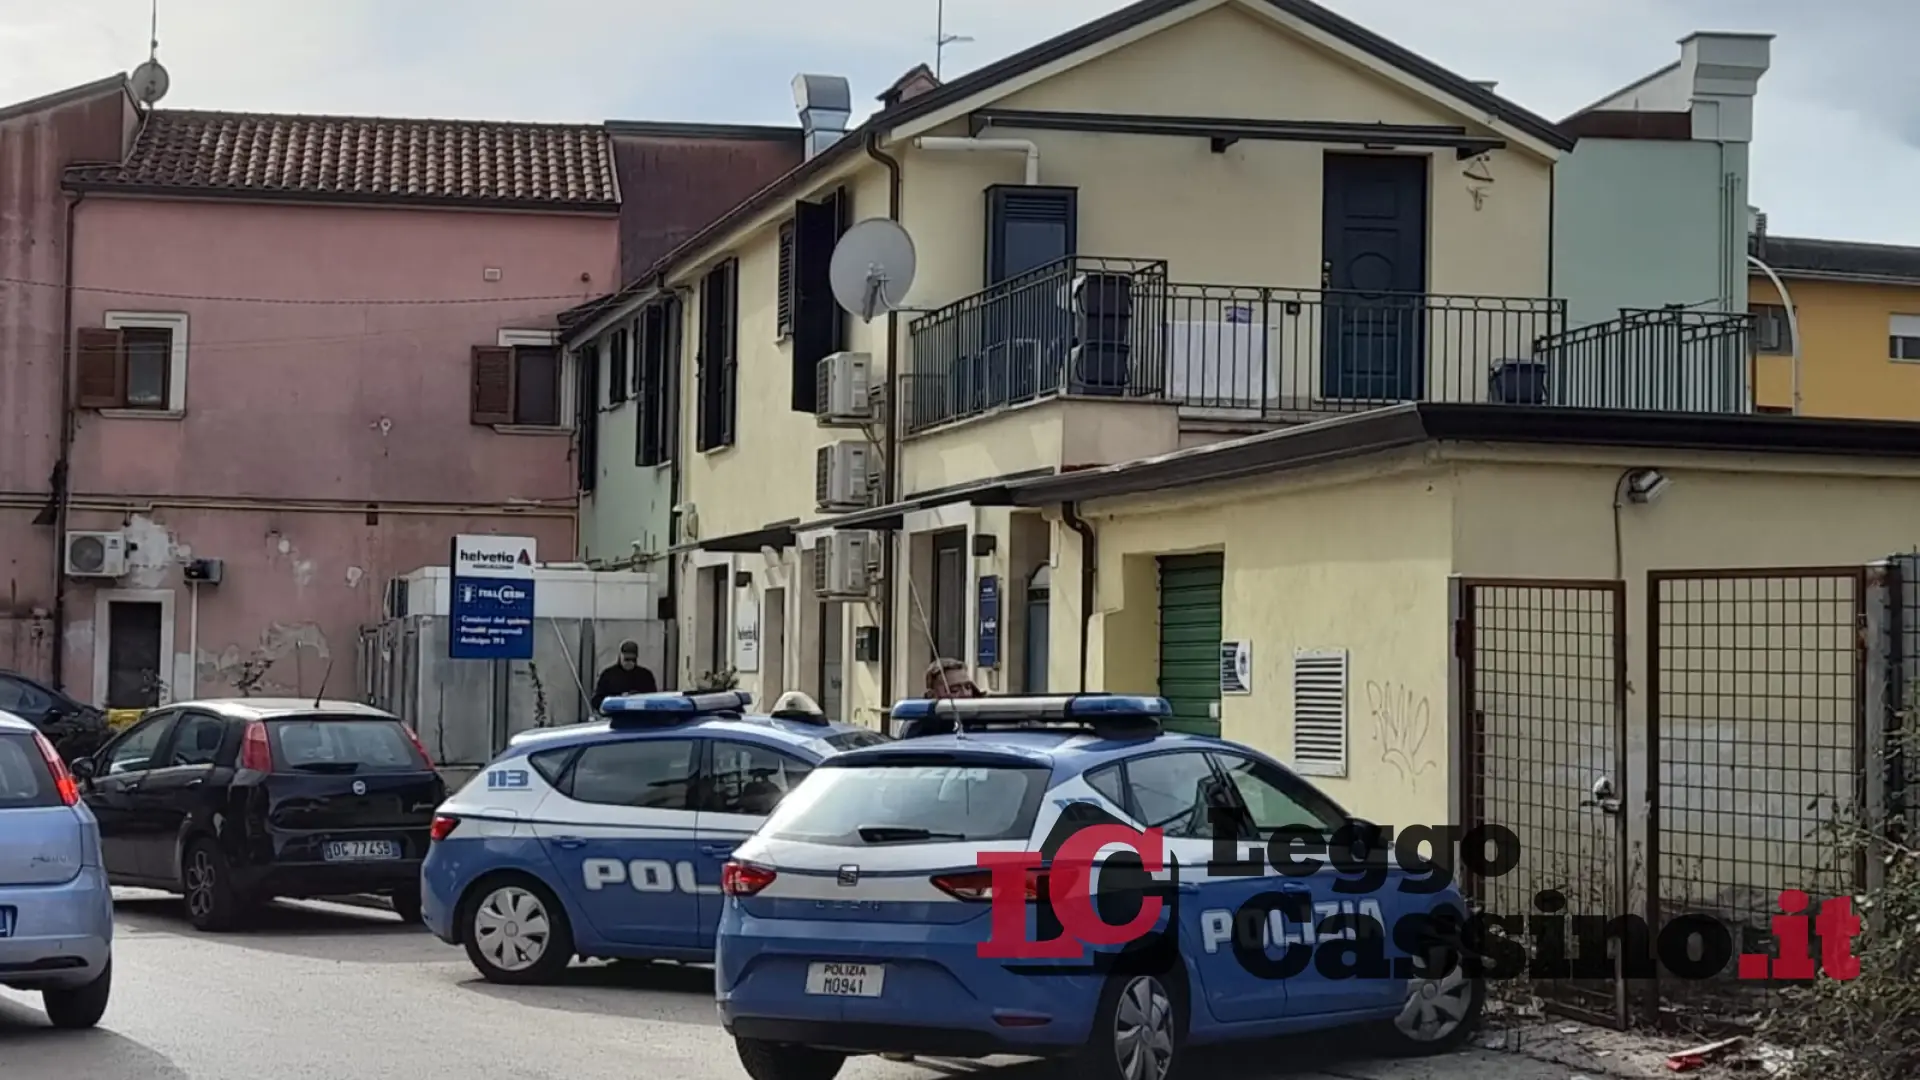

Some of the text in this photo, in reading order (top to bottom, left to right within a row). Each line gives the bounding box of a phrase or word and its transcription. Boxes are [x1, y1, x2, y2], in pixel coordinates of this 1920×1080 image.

[460, 549, 515, 563] helvetia
[488, 770, 529, 787] 113
[823, 963, 867, 977] POLIZIA
